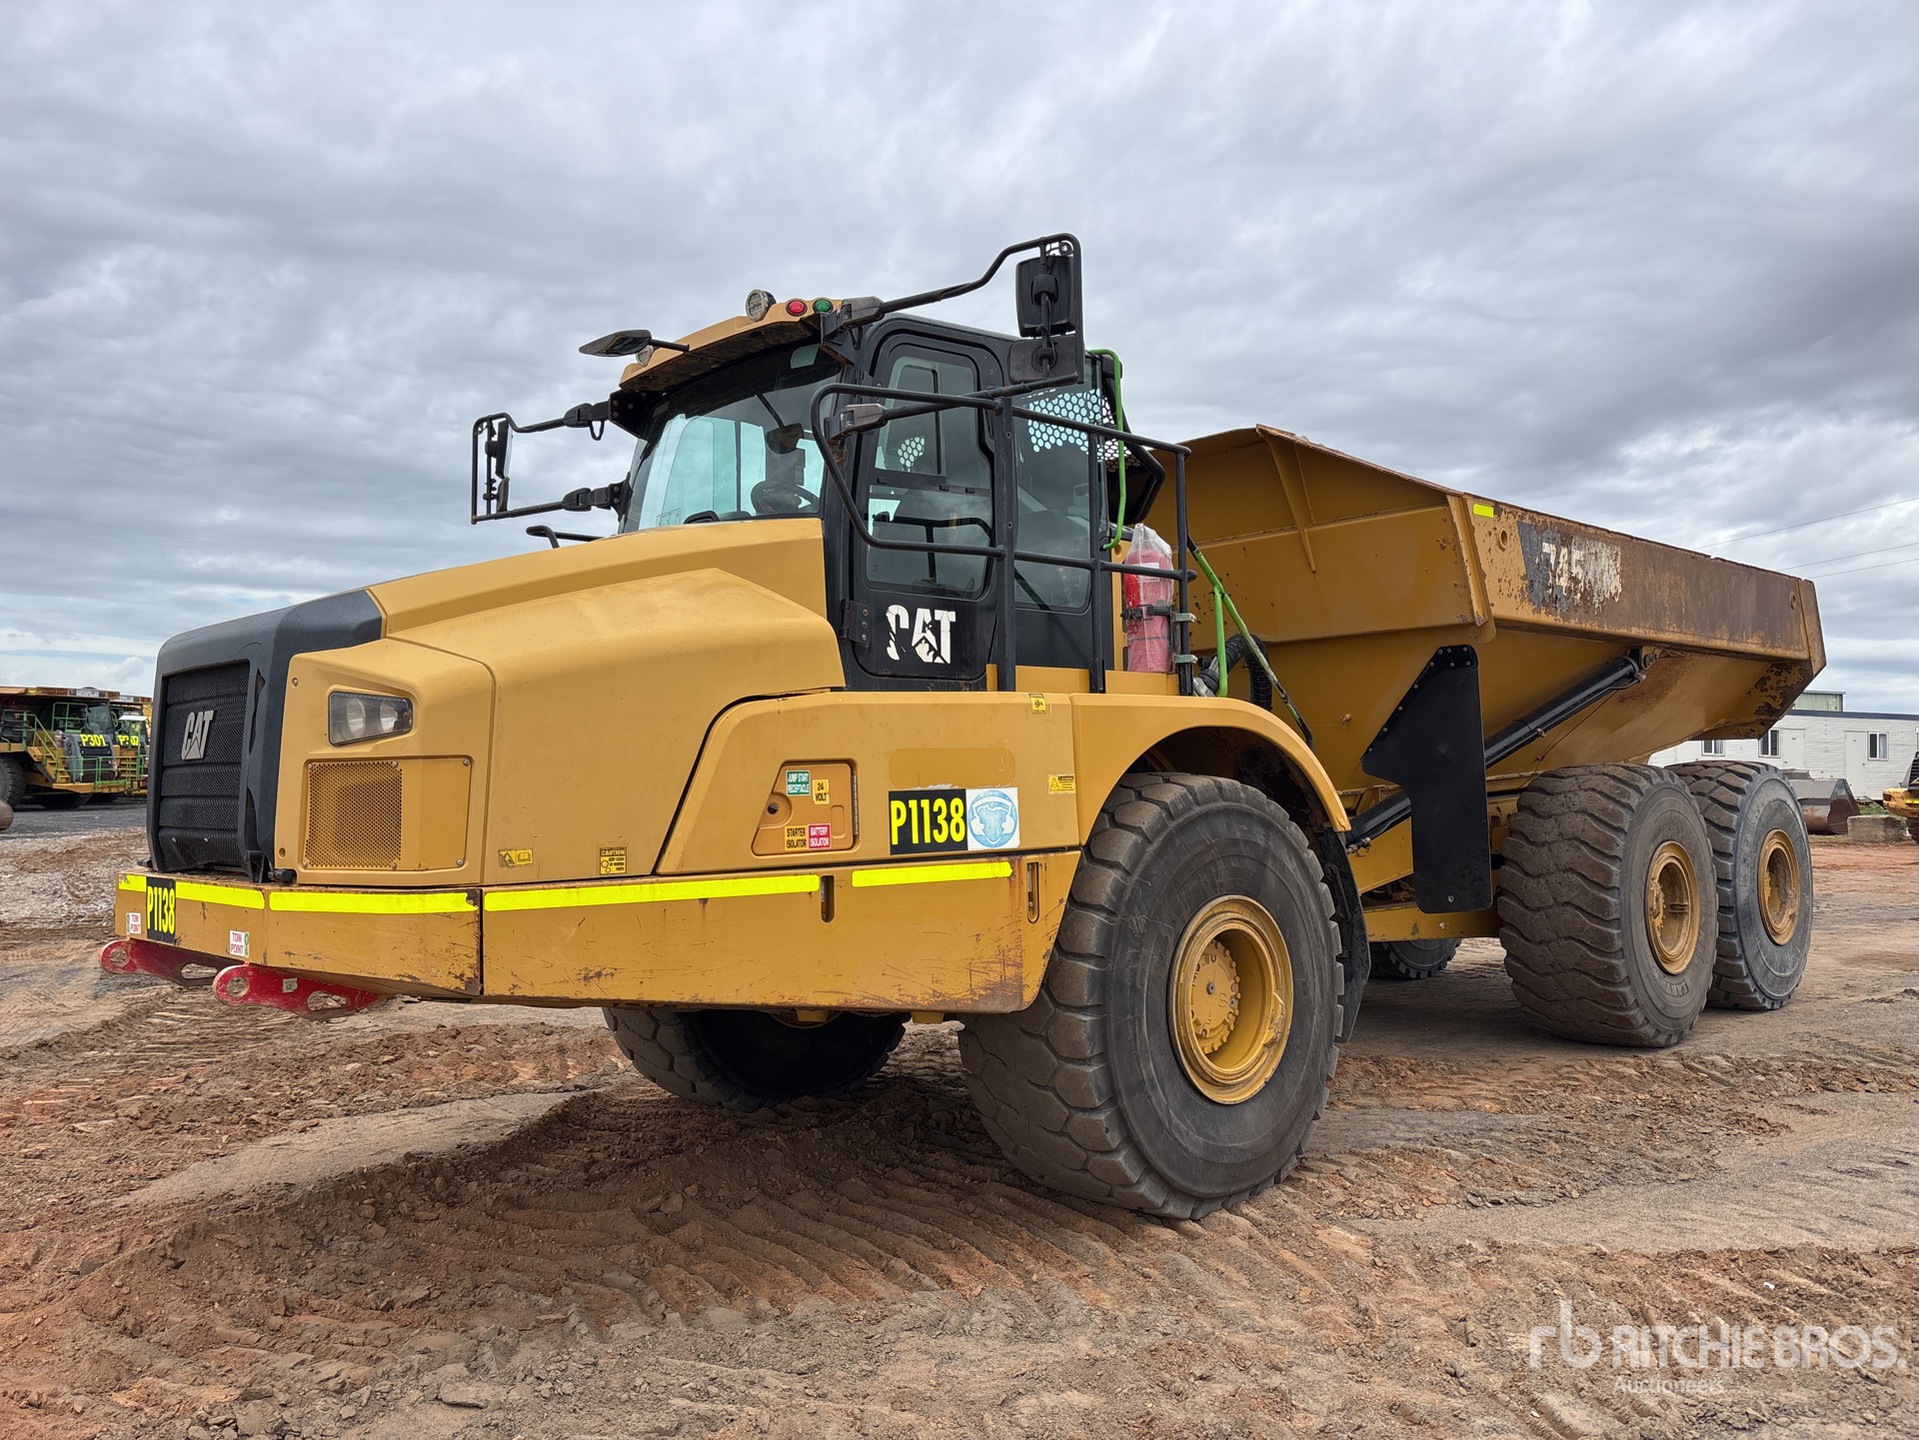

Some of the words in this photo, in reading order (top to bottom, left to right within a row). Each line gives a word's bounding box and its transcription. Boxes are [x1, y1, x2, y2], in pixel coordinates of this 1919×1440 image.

[886, 604, 956, 664] CAT
[80, 734, 106, 746] P301
[181, 710, 214, 760] CAT
[817, 782, 824, 791] 24
[815, 793, 827, 801] VOLT
[890, 797, 966, 845] P1138
[147, 886, 175, 934] P1138
[130, 914, 140, 923] TOW
[130, 924, 141, 932] POINT
[231, 932, 242, 943] TOW
[230, 943, 244, 954] POINT
